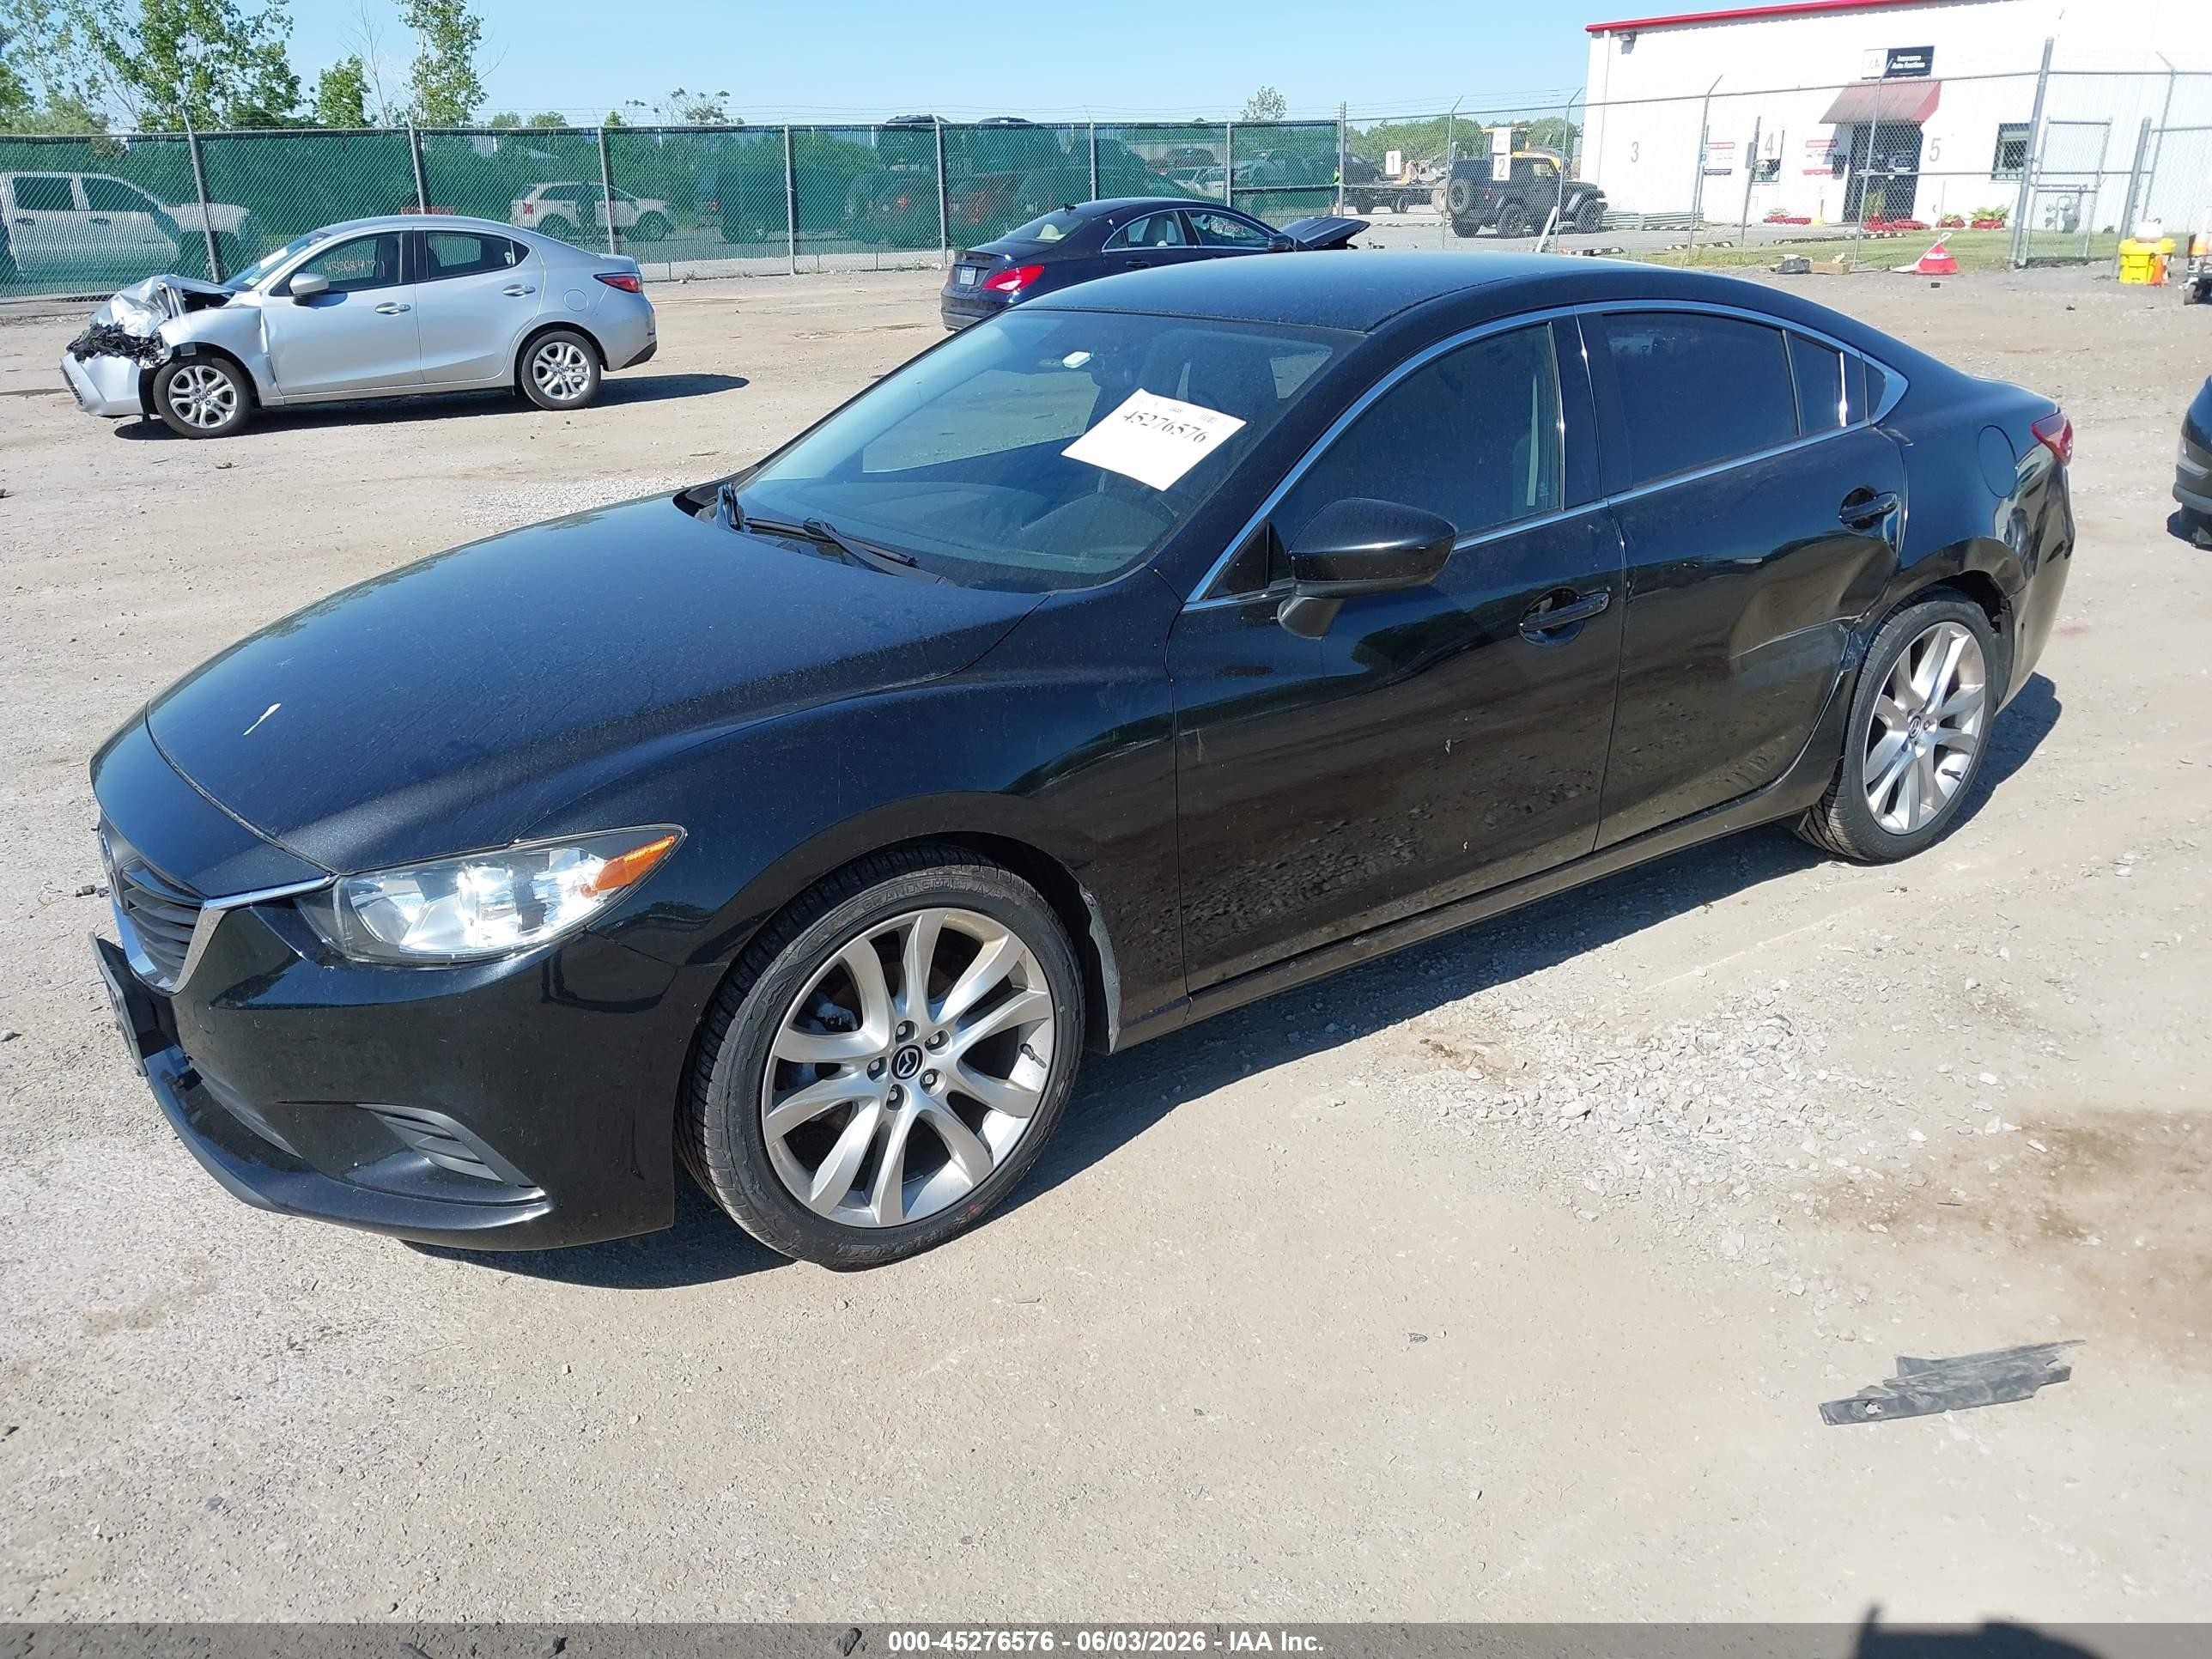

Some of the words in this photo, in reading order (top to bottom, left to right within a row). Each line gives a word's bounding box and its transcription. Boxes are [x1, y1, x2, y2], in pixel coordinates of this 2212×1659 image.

[1631, 141, 1639, 163] 3
[1764, 132, 1774, 155] 4
[1929, 137, 1942, 162] 5
[1389, 154, 1395, 172] 1
[1498, 158, 1505, 178] 2
[1123, 410, 1209, 443] 45276576
